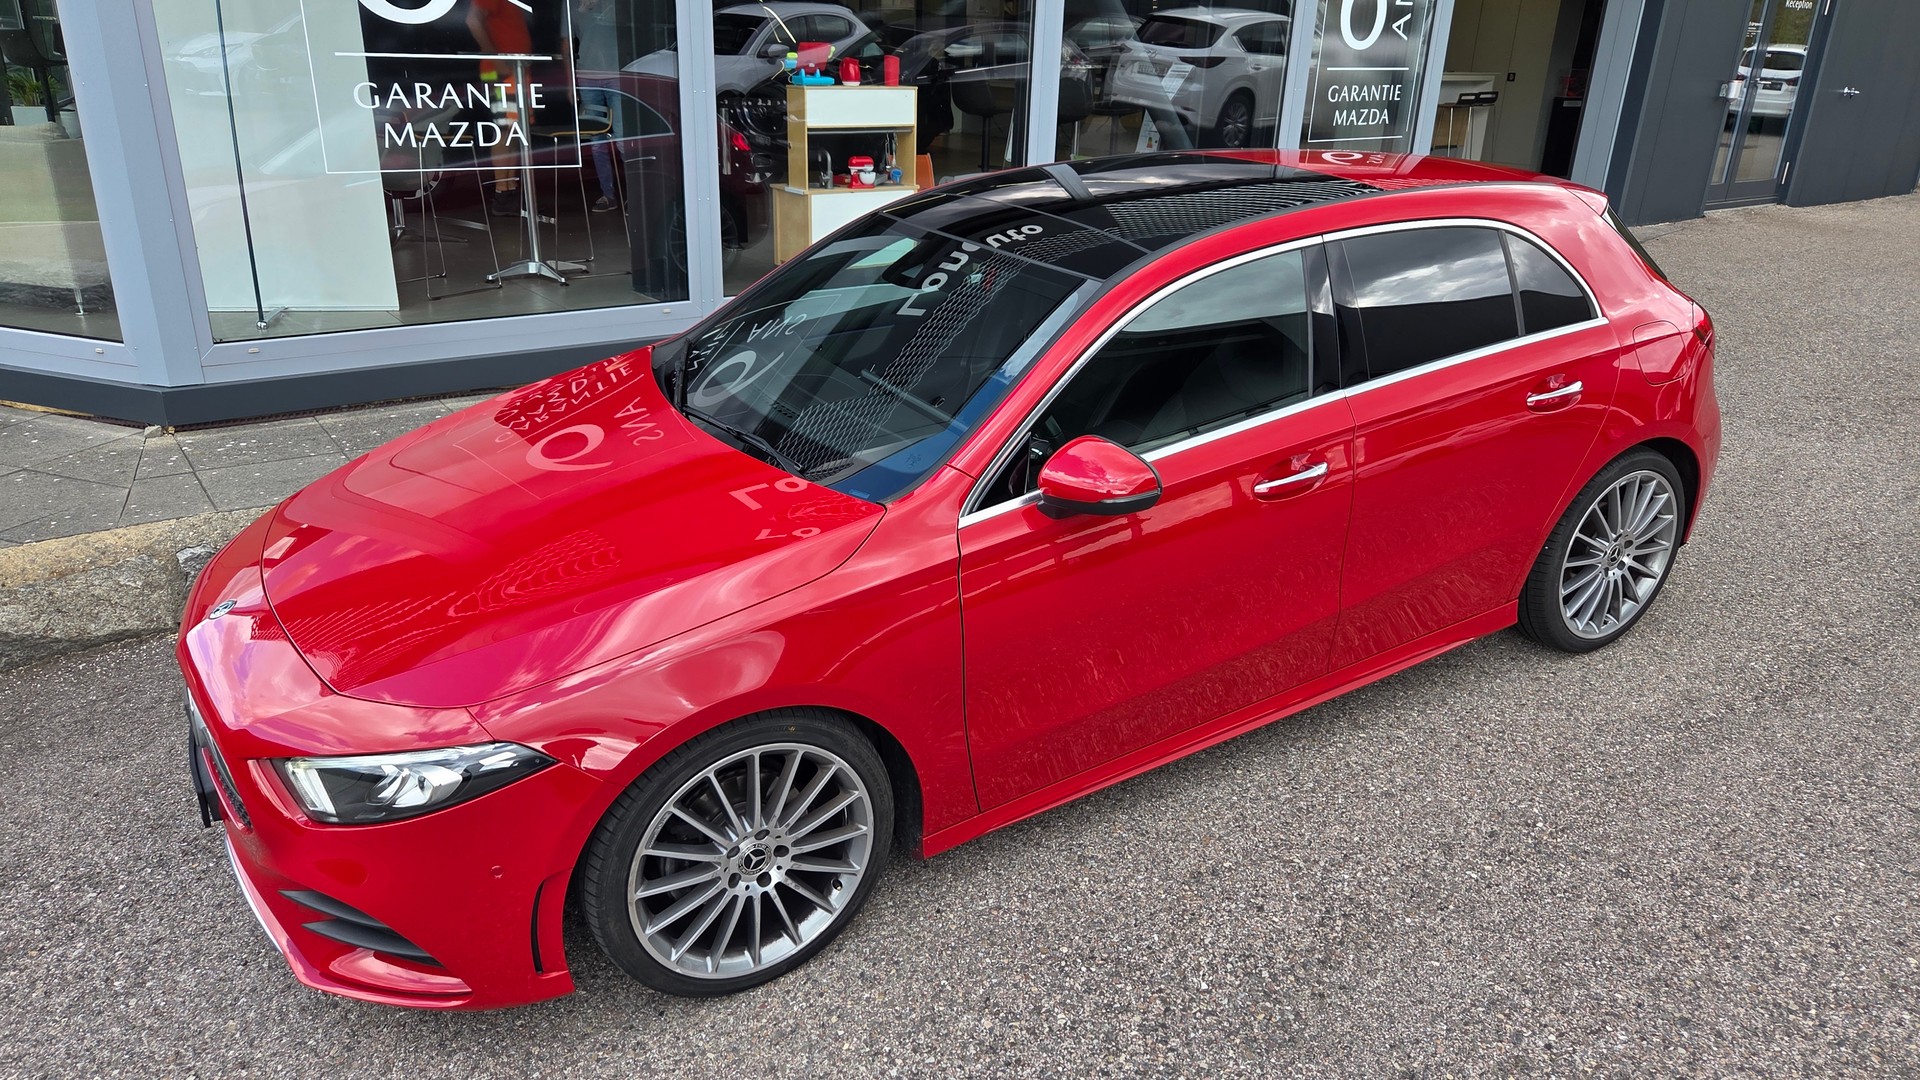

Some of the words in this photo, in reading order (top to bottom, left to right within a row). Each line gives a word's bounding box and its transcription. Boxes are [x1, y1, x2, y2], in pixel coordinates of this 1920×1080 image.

[353, 82, 546, 109] GARANTIE
[1328, 84, 1402, 102] GARANTIE
[1332, 108, 1390, 127] MAZDA
[384, 121, 529, 149] MAZDA
